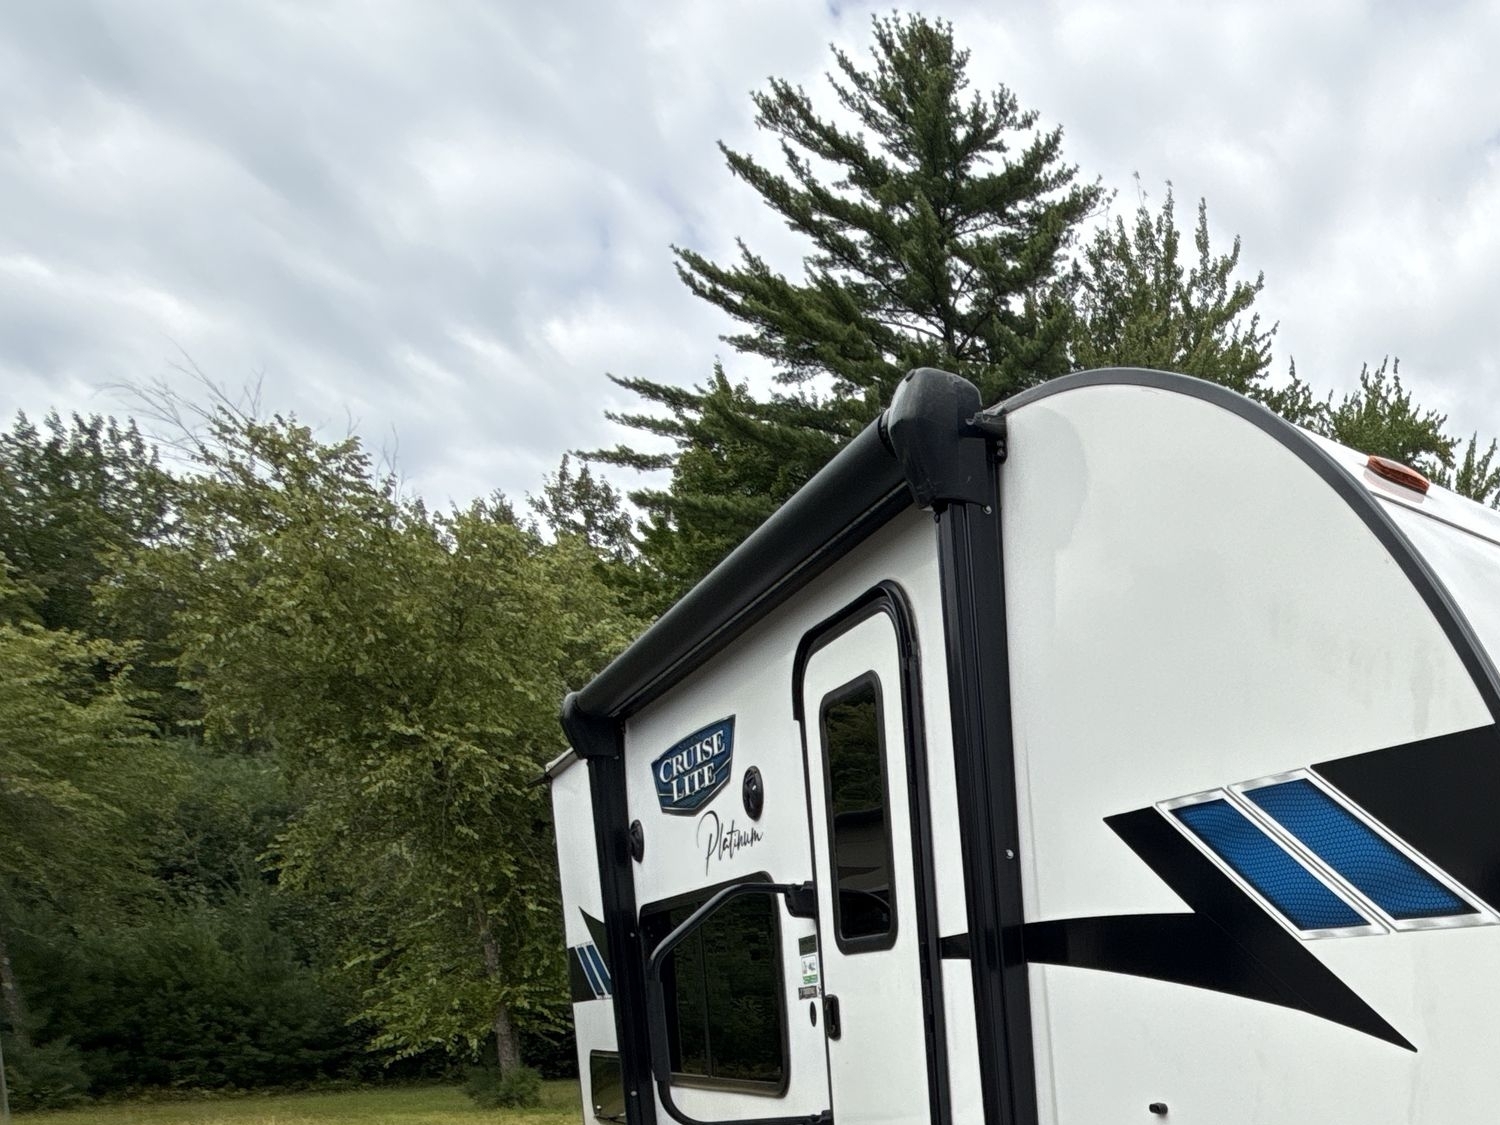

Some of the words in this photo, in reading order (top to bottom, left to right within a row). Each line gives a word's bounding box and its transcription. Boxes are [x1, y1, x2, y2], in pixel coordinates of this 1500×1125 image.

[659, 730, 725, 783] CRUISE
[672, 763, 716, 803] LITE
[697, 810, 763, 876] Platinum
